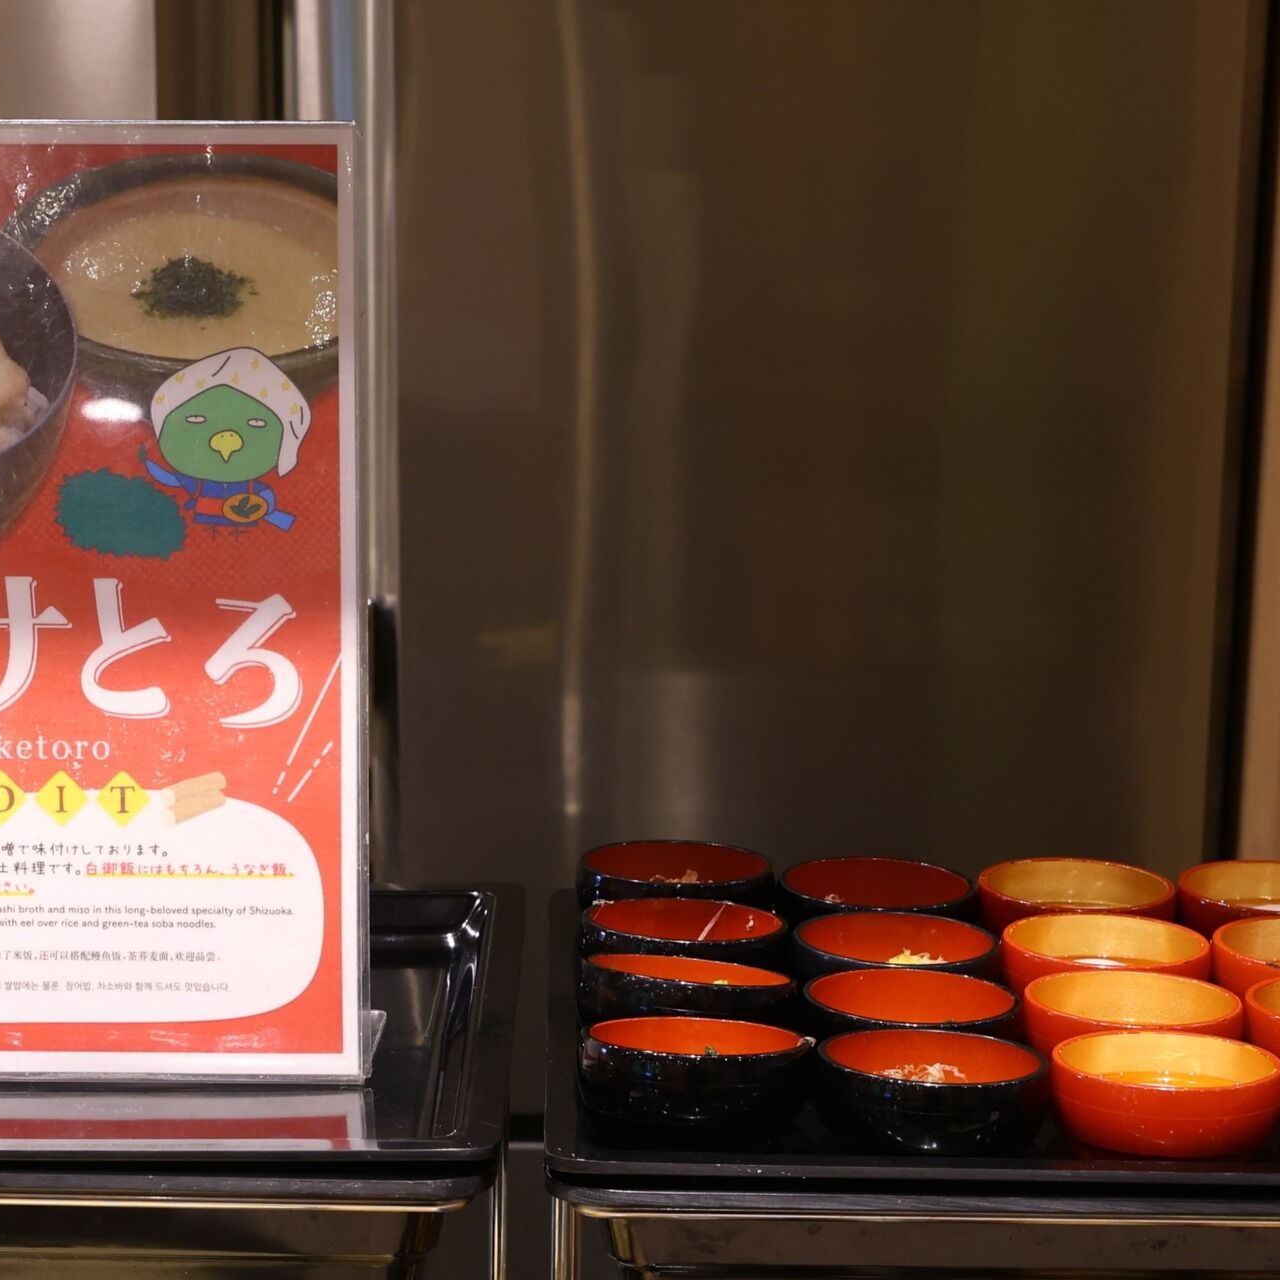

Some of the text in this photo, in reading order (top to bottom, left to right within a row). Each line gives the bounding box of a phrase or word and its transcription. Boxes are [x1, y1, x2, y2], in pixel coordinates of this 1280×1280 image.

[18, 905, 45, 914] broth
[47, 905, 66, 914] and
[68, 905, 90, 914] miso
[93, 905, 102, 914] in
[105, 905, 122, 914] this
[124, 905, 189, 916] long-beloved
[191, 906, 234, 917] specialty
[236, 906, 246, 915] of
[249, 906, 295, 915] Shizuoka.
[20, 918, 35, 927] eel
[61, 919, 79, 927] rice
[81, 919, 100, 928] and
[102, 919, 149, 930] green-tea
[151, 920, 174, 928] soba
[176, 920, 217, 929] noodles.
